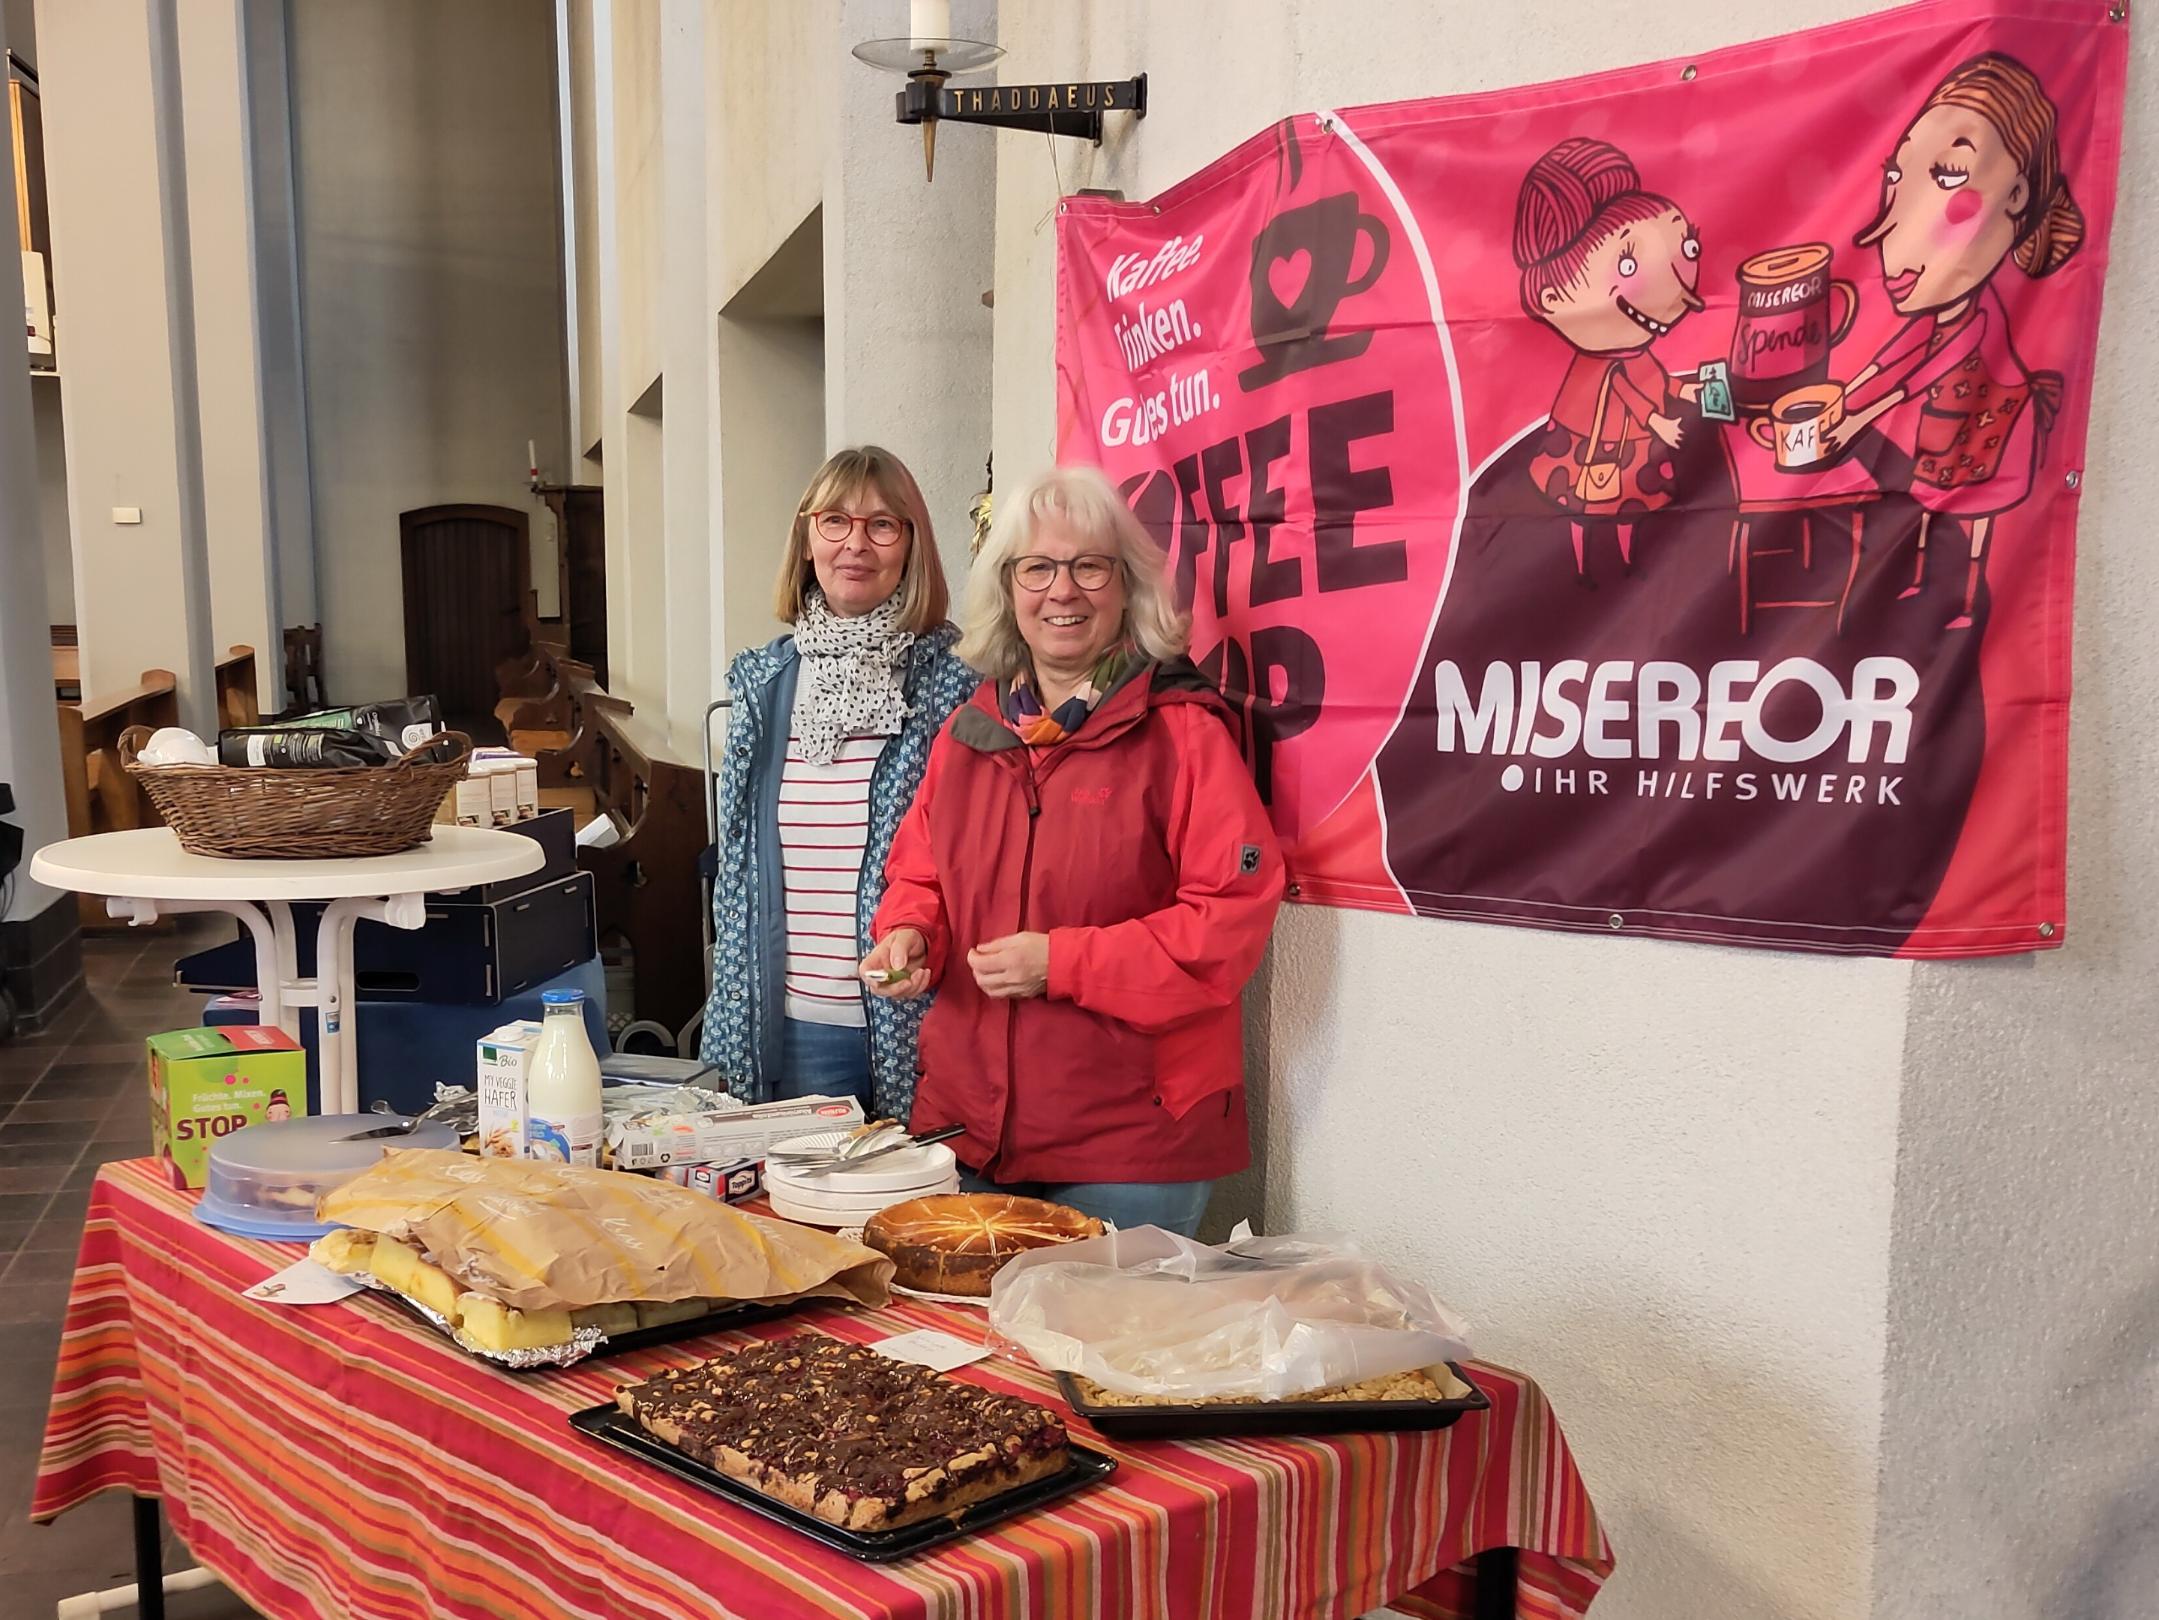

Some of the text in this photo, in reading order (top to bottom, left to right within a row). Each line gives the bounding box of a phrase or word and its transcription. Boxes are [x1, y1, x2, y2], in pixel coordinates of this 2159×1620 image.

[954, 85, 1114, 113] THADDAEUS
[1748, 276, 1822, 308] MISEREOR
[1739, 321, 1822, 373] Spende
[1101, 369, 1220, 447] Gues tun.
[1118, 389, 1408, 618] OFFEE
[1434, 656, 1920, 764] MISEREOR
[1535, 767, 1903, 806] IHR HILFSWERK
[499, 1055, 517, 1067] Bio
[484, 1075, 517, 1090] MY VEGGIE
[484, 1089, 517, 1110] HAFER
[176, 1115, 248, 1141] STOP
